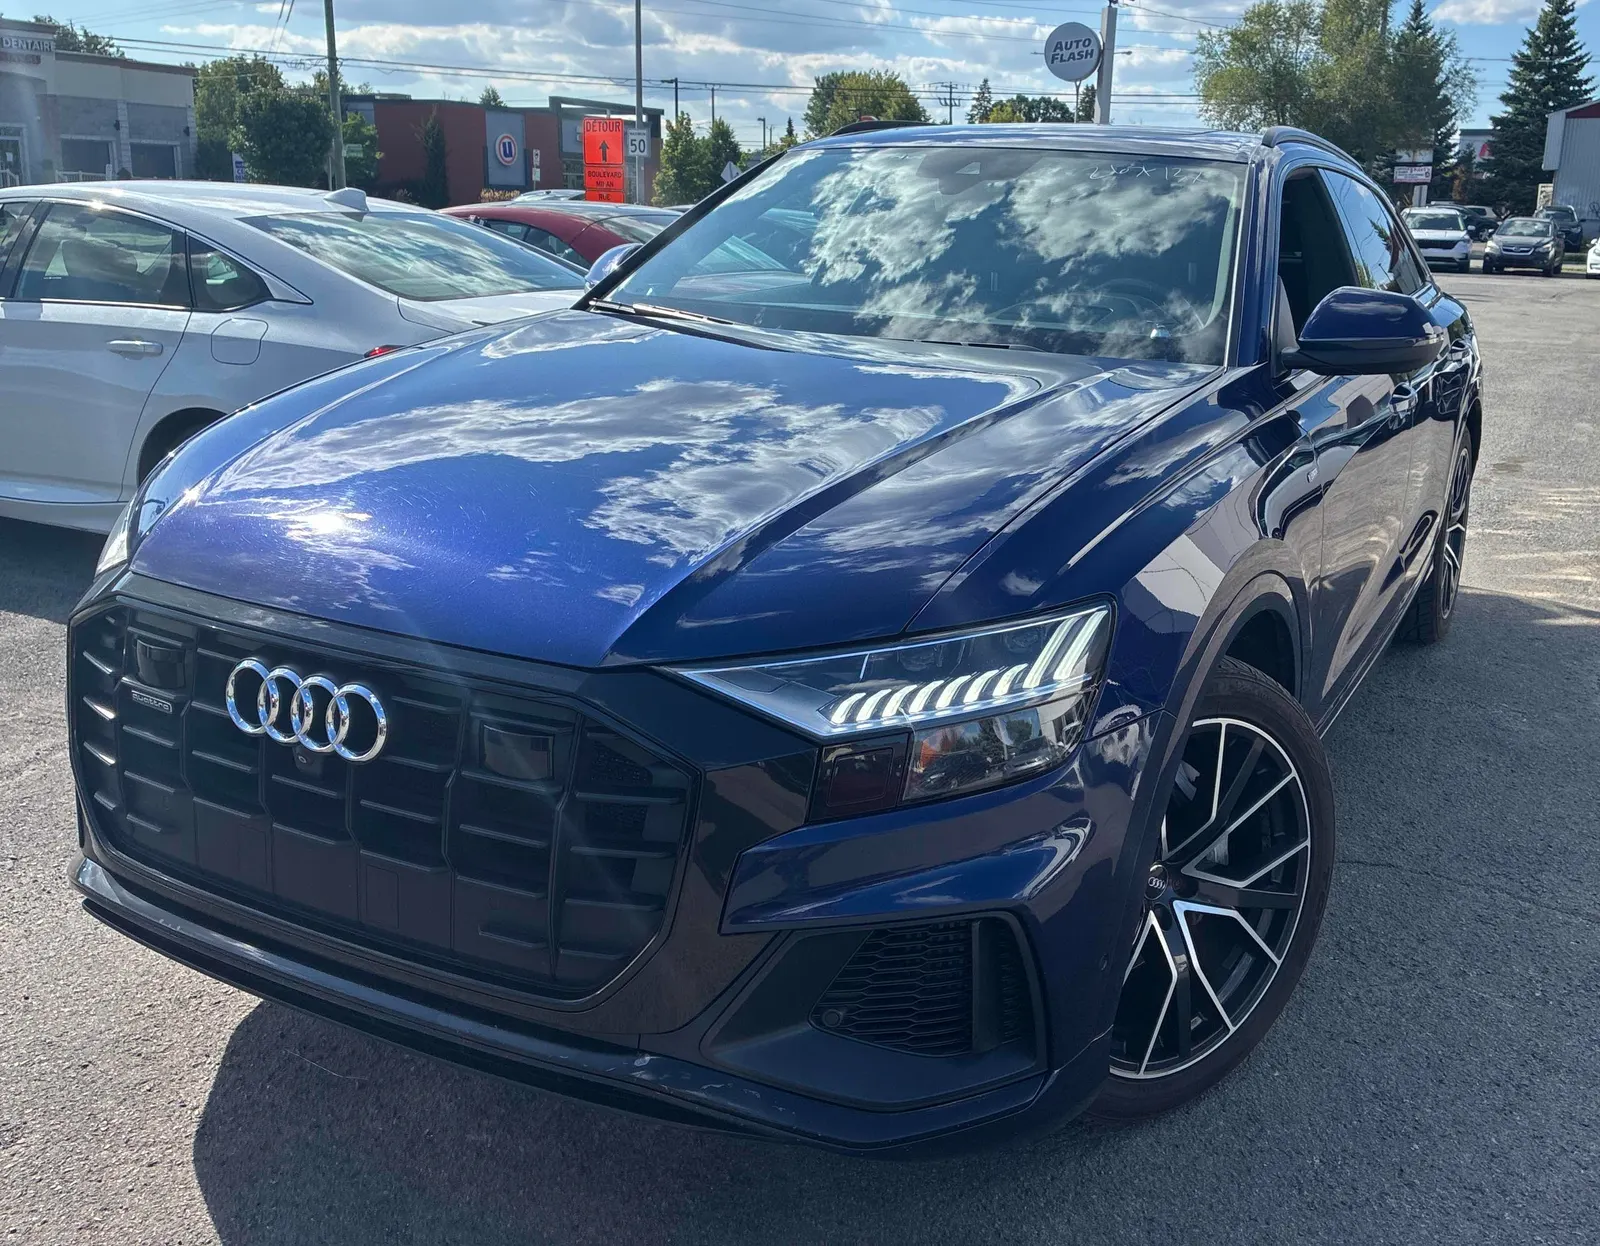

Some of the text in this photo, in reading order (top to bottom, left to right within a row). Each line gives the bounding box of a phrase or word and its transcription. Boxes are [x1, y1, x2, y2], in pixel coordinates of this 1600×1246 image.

[1053, 37, 1092, 52] AUTO
[1050, 49, 1094, 64] FLASH
[630, 139, 646, 153] 50
[587, 170, 622, 178] BOULEVARD
[598, 193, 611, 201] RUE
[132, 693, 170, 710] quattro
